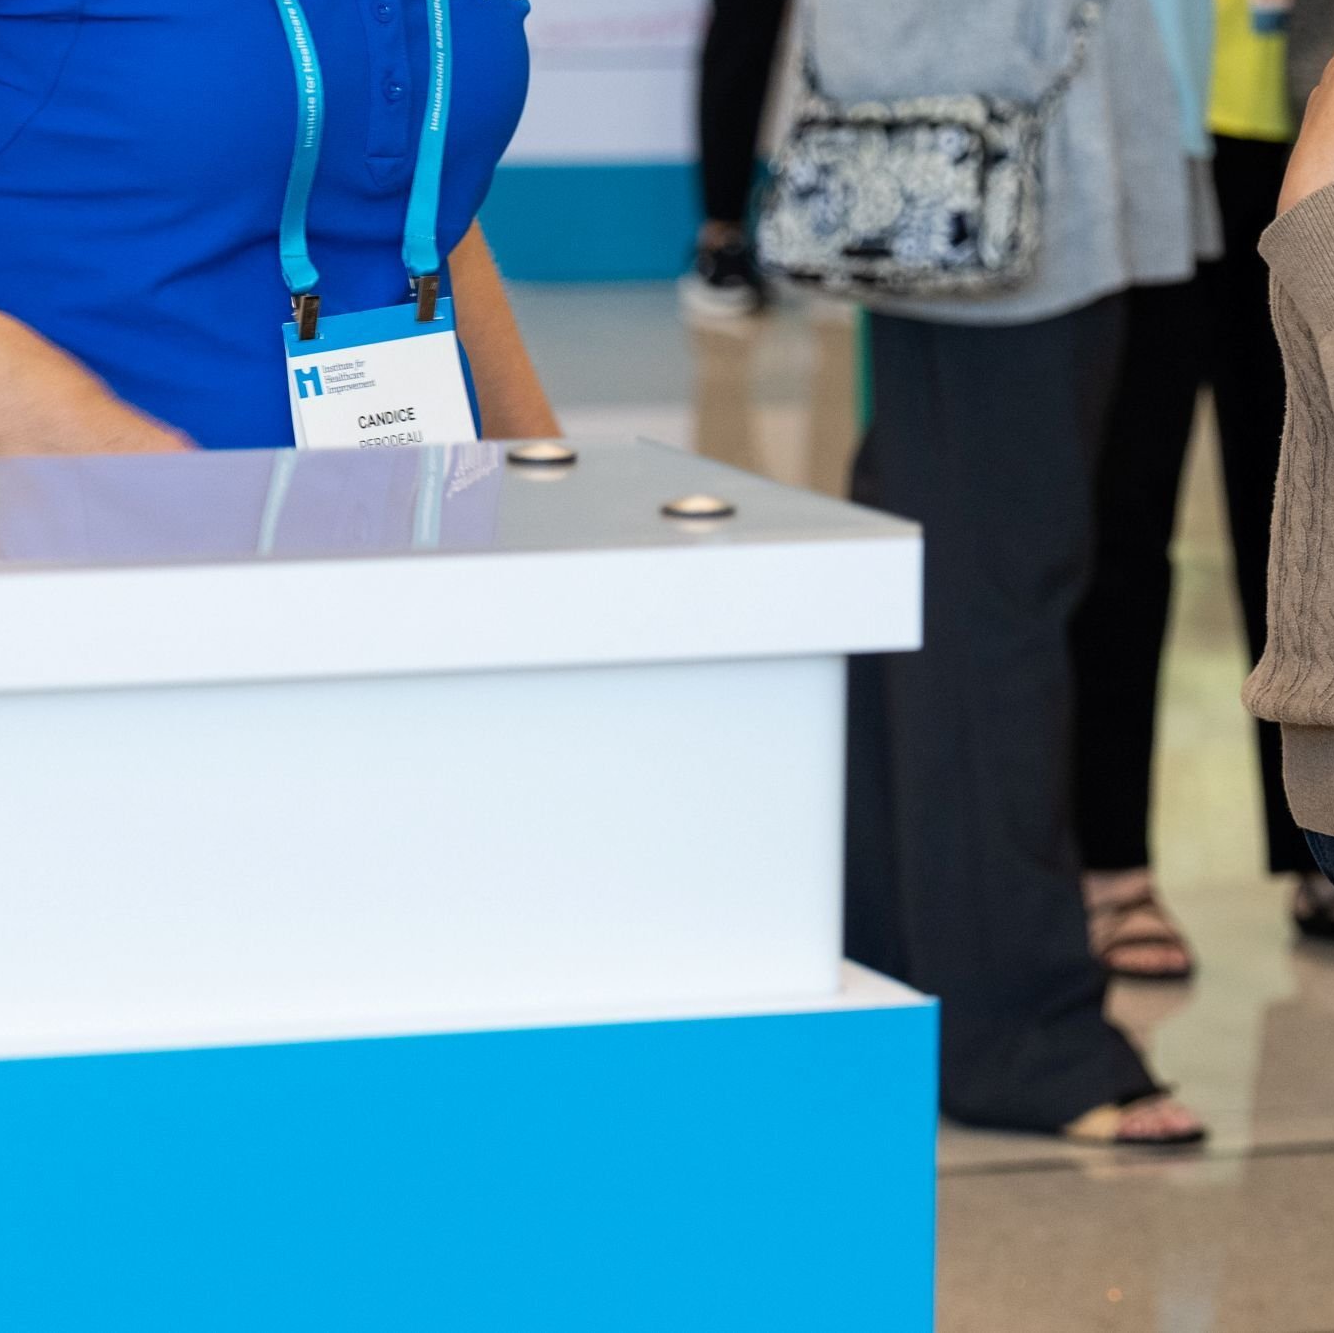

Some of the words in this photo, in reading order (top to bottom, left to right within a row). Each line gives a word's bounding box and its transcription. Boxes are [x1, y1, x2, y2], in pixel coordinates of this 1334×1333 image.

[287, 7, 314, 73] Healthcare
[304, 74, 316, 94] for
[430, 51, 445, 132] Improvement
[303, 96, 316, 148] Institute
[322, 362, 354, 374] Institute
[323, 371, 366, 384] Healthcare
[326, 380, 376, 395] Improvement
[358, 407, 416, 429] CANDICE
